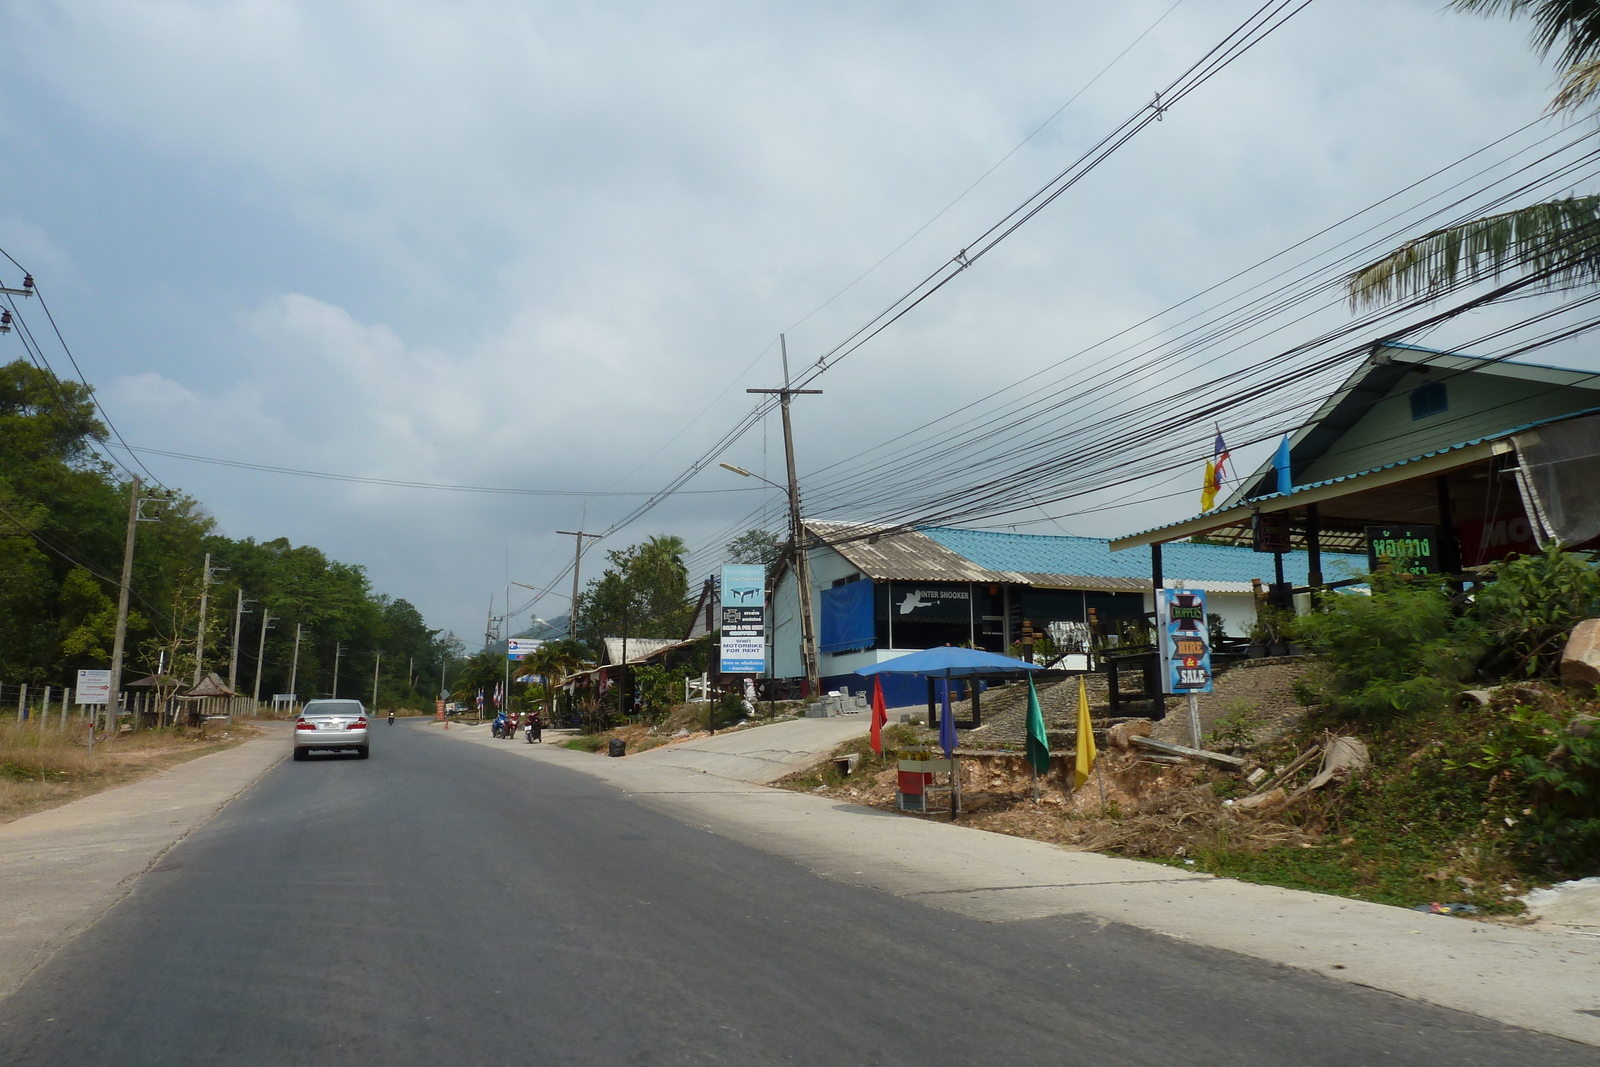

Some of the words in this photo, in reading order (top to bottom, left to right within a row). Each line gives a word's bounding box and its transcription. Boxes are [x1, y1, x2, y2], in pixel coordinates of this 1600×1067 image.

[920, 590, 939, 598] INTER
[940, 591, 969, 600] SNOOKER
[1171, 606, 1202, 618] CHOPPERS
[1177, 641, 1203, 655] HIRE
[1186, 657, 1195, 667] &
[1181, 669, 1206, 684] SALE
